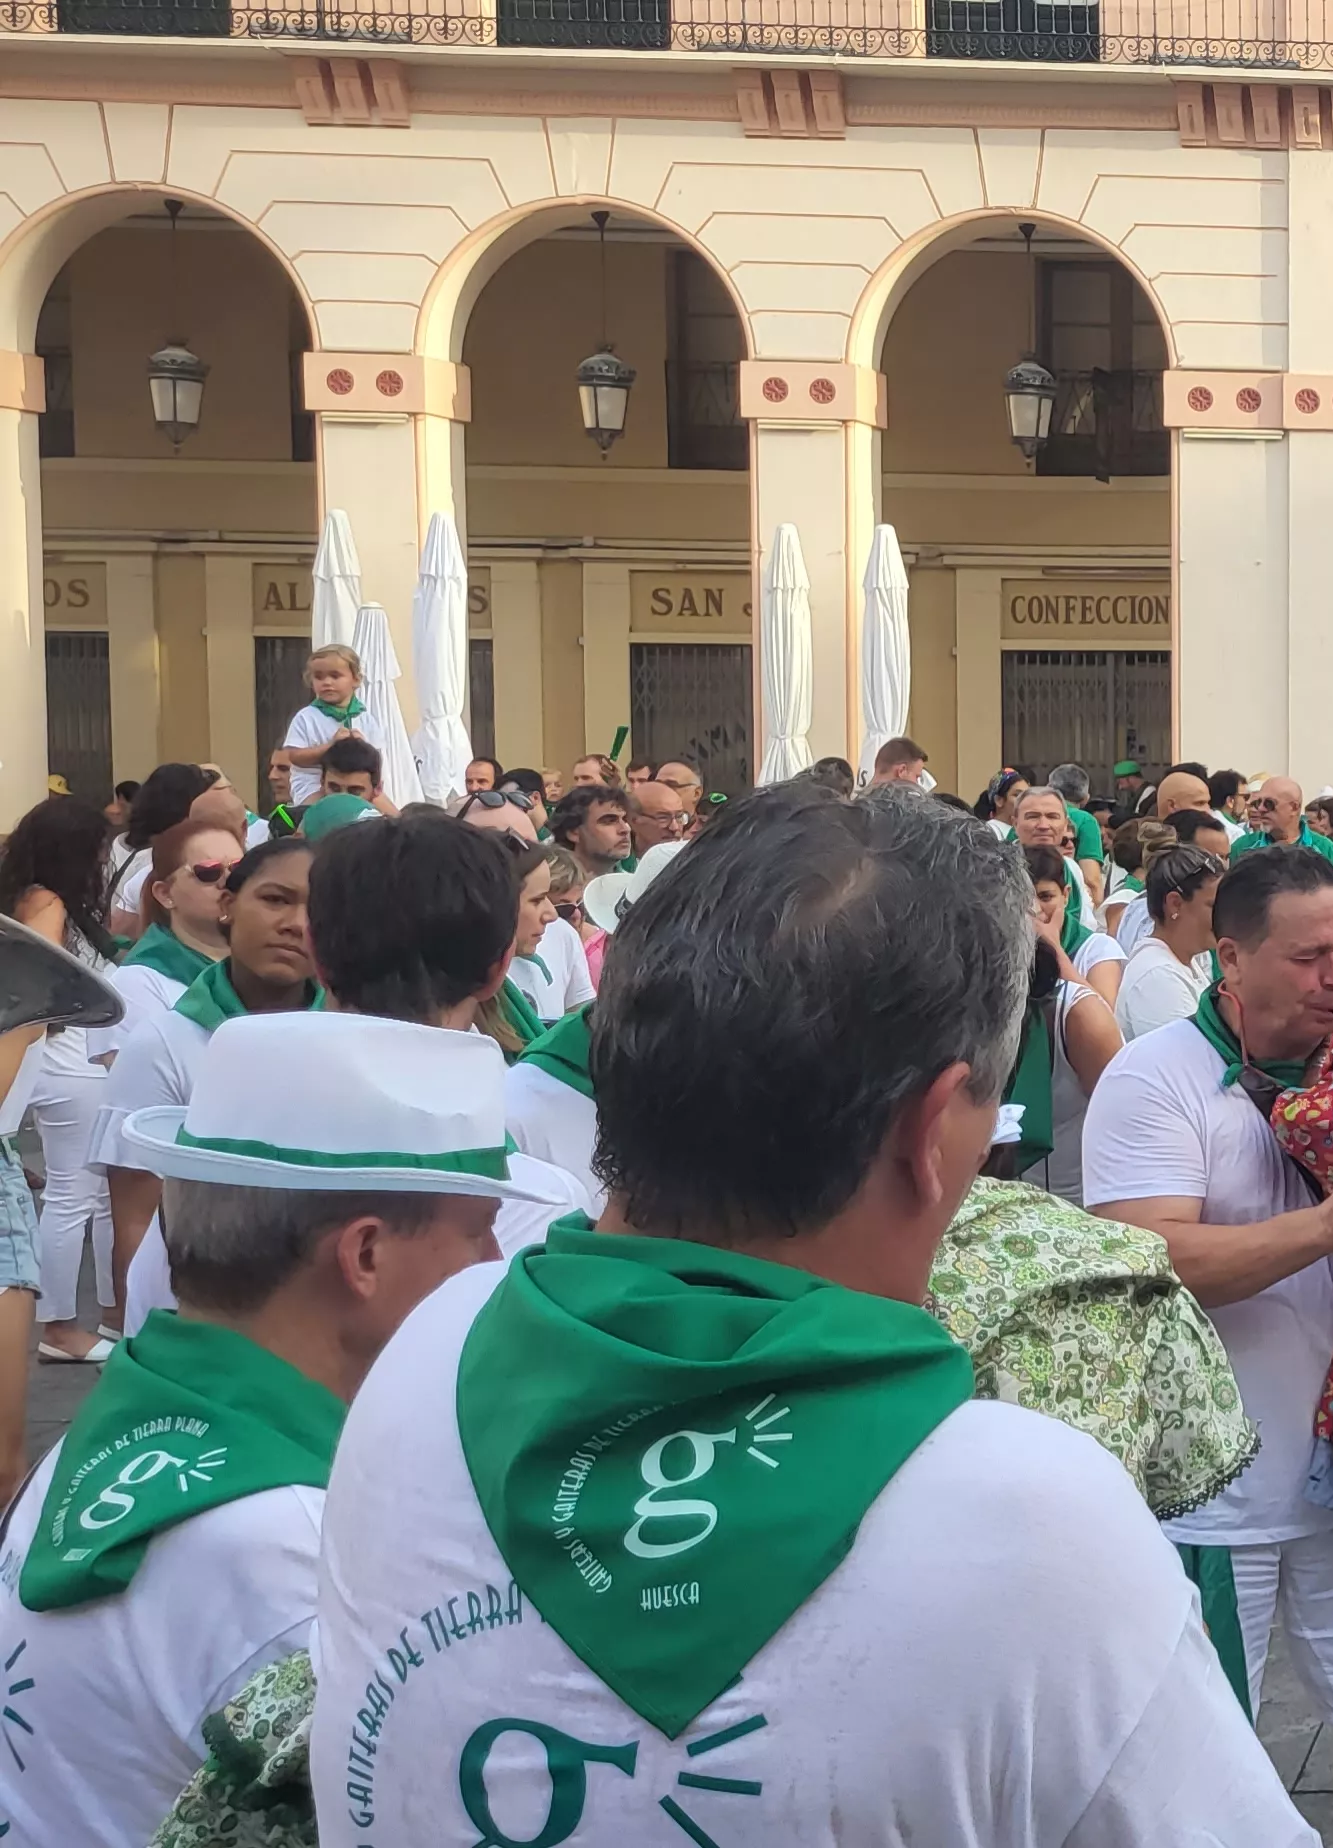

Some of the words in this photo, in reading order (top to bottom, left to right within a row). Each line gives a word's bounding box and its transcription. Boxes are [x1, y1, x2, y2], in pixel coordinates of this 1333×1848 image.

[651, 588, 725, 617] SAN
[132, 1416, 172, 1442] TIERRA
[174, 1416, 209, 1438] PLANA
[552, 1451, 596, 1522] GAITERAS
[640, 1581, 700, 1611] HUESCA
[347, 1669, 395, 1828] GAITERAS
[387, 1626, 425, 1684] DE
[421, 1579, 524, 1653] TIERRA
